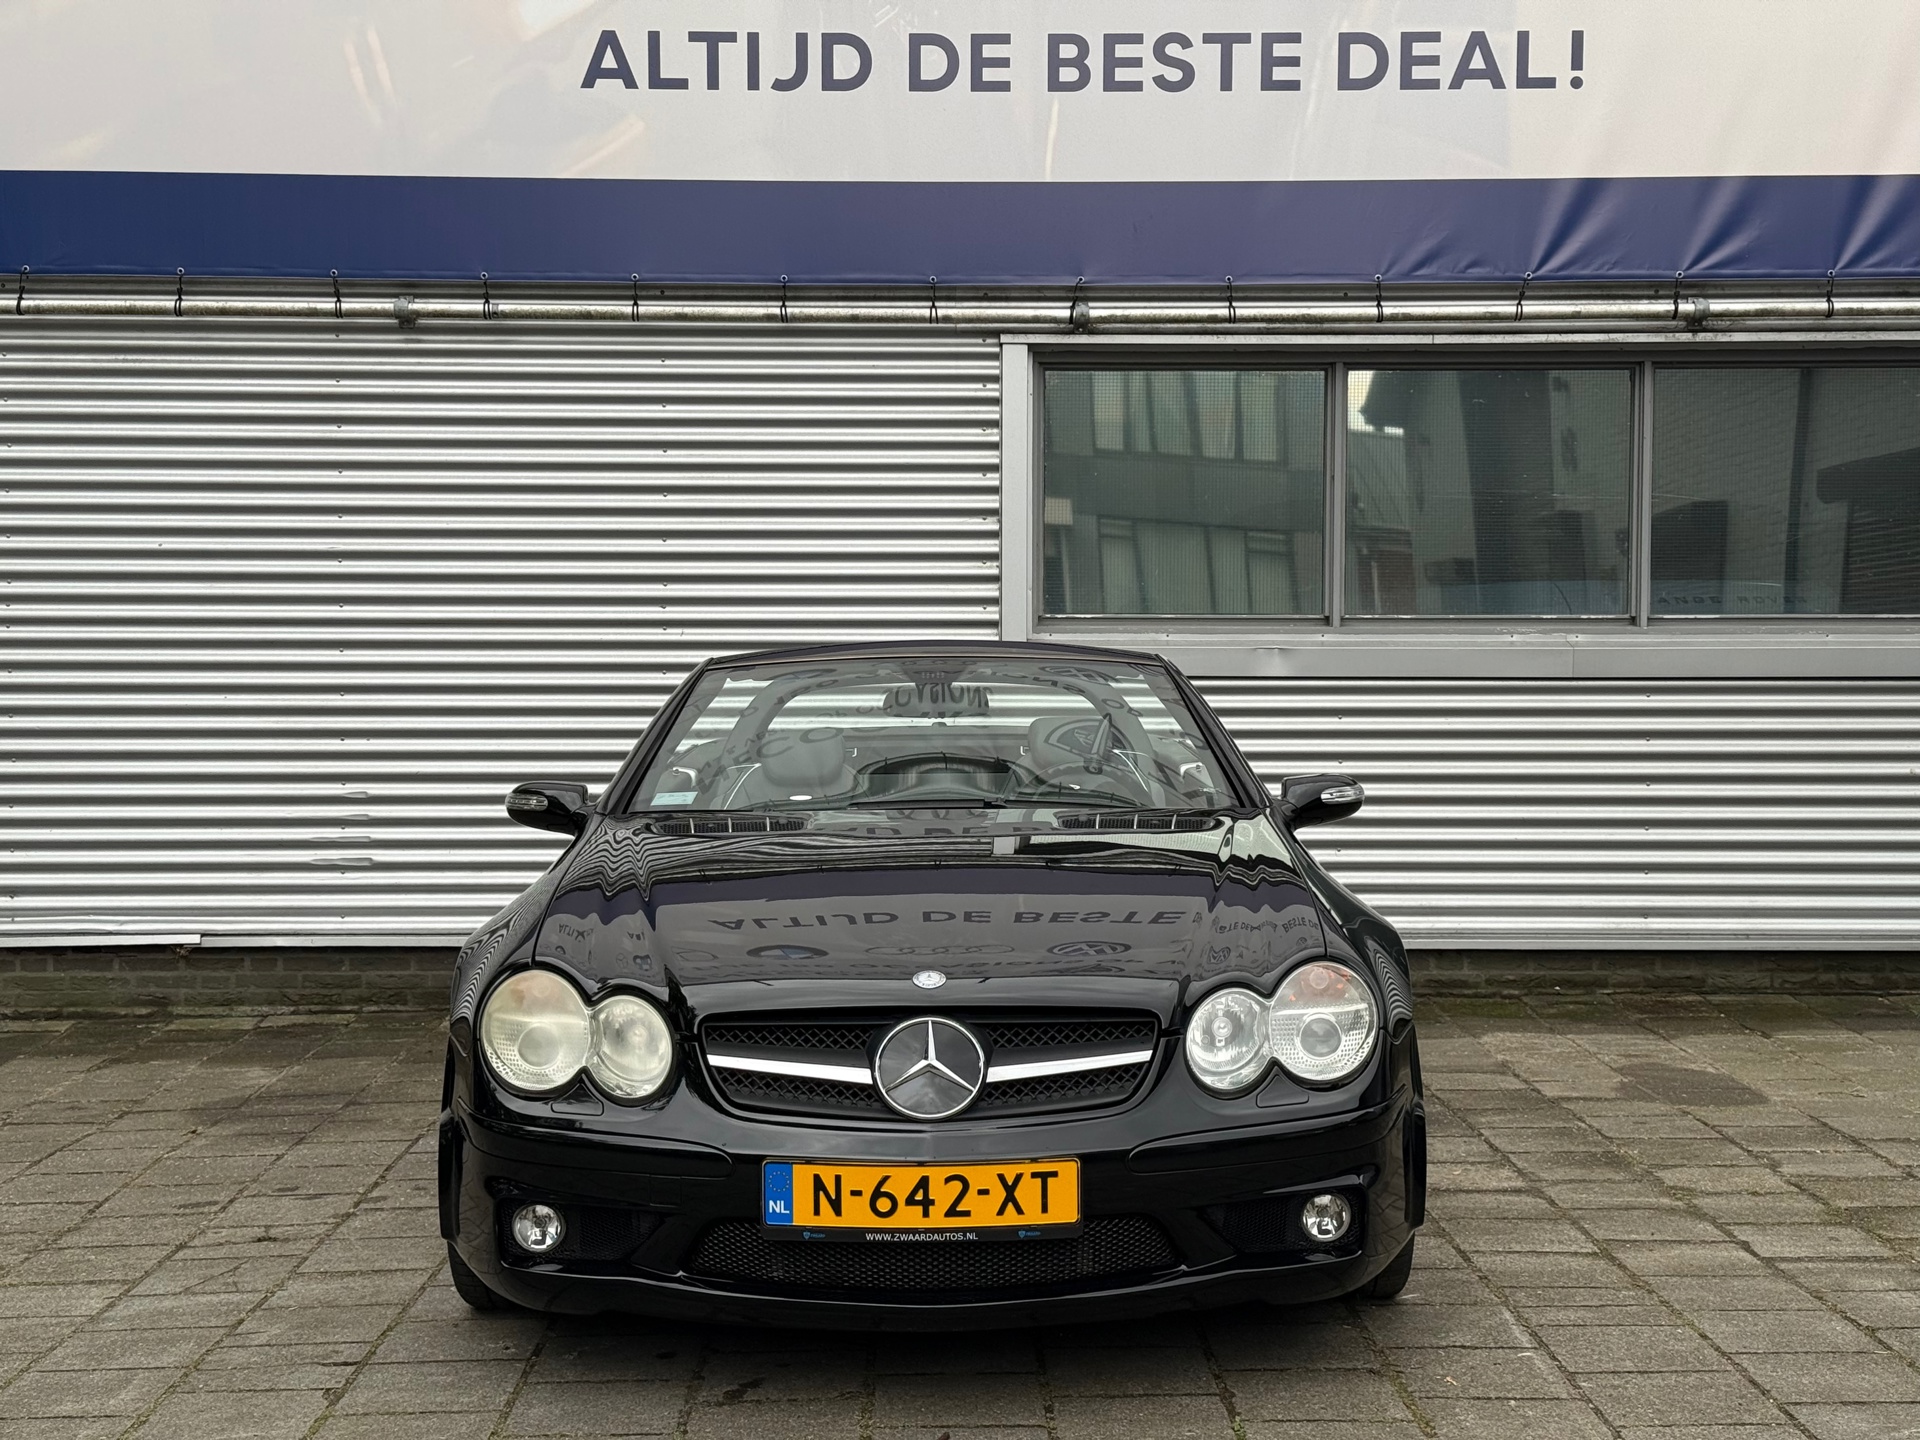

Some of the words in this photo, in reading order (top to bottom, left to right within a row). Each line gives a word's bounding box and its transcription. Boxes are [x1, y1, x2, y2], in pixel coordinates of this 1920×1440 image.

[581, 30, 872, 91] ALTIJD
[909, 33, 1010, 92] DE
[1048, 33, 1301, 92] BESTE
[1338, 31, 1583, 90] DEAL!
[769, 1199, 790, 1214] NL
[812, 1170, 1059, 1218] N-642-XT
[865, 1232, 979, 1242] WWW.ZWAARDAUTOS.NL
